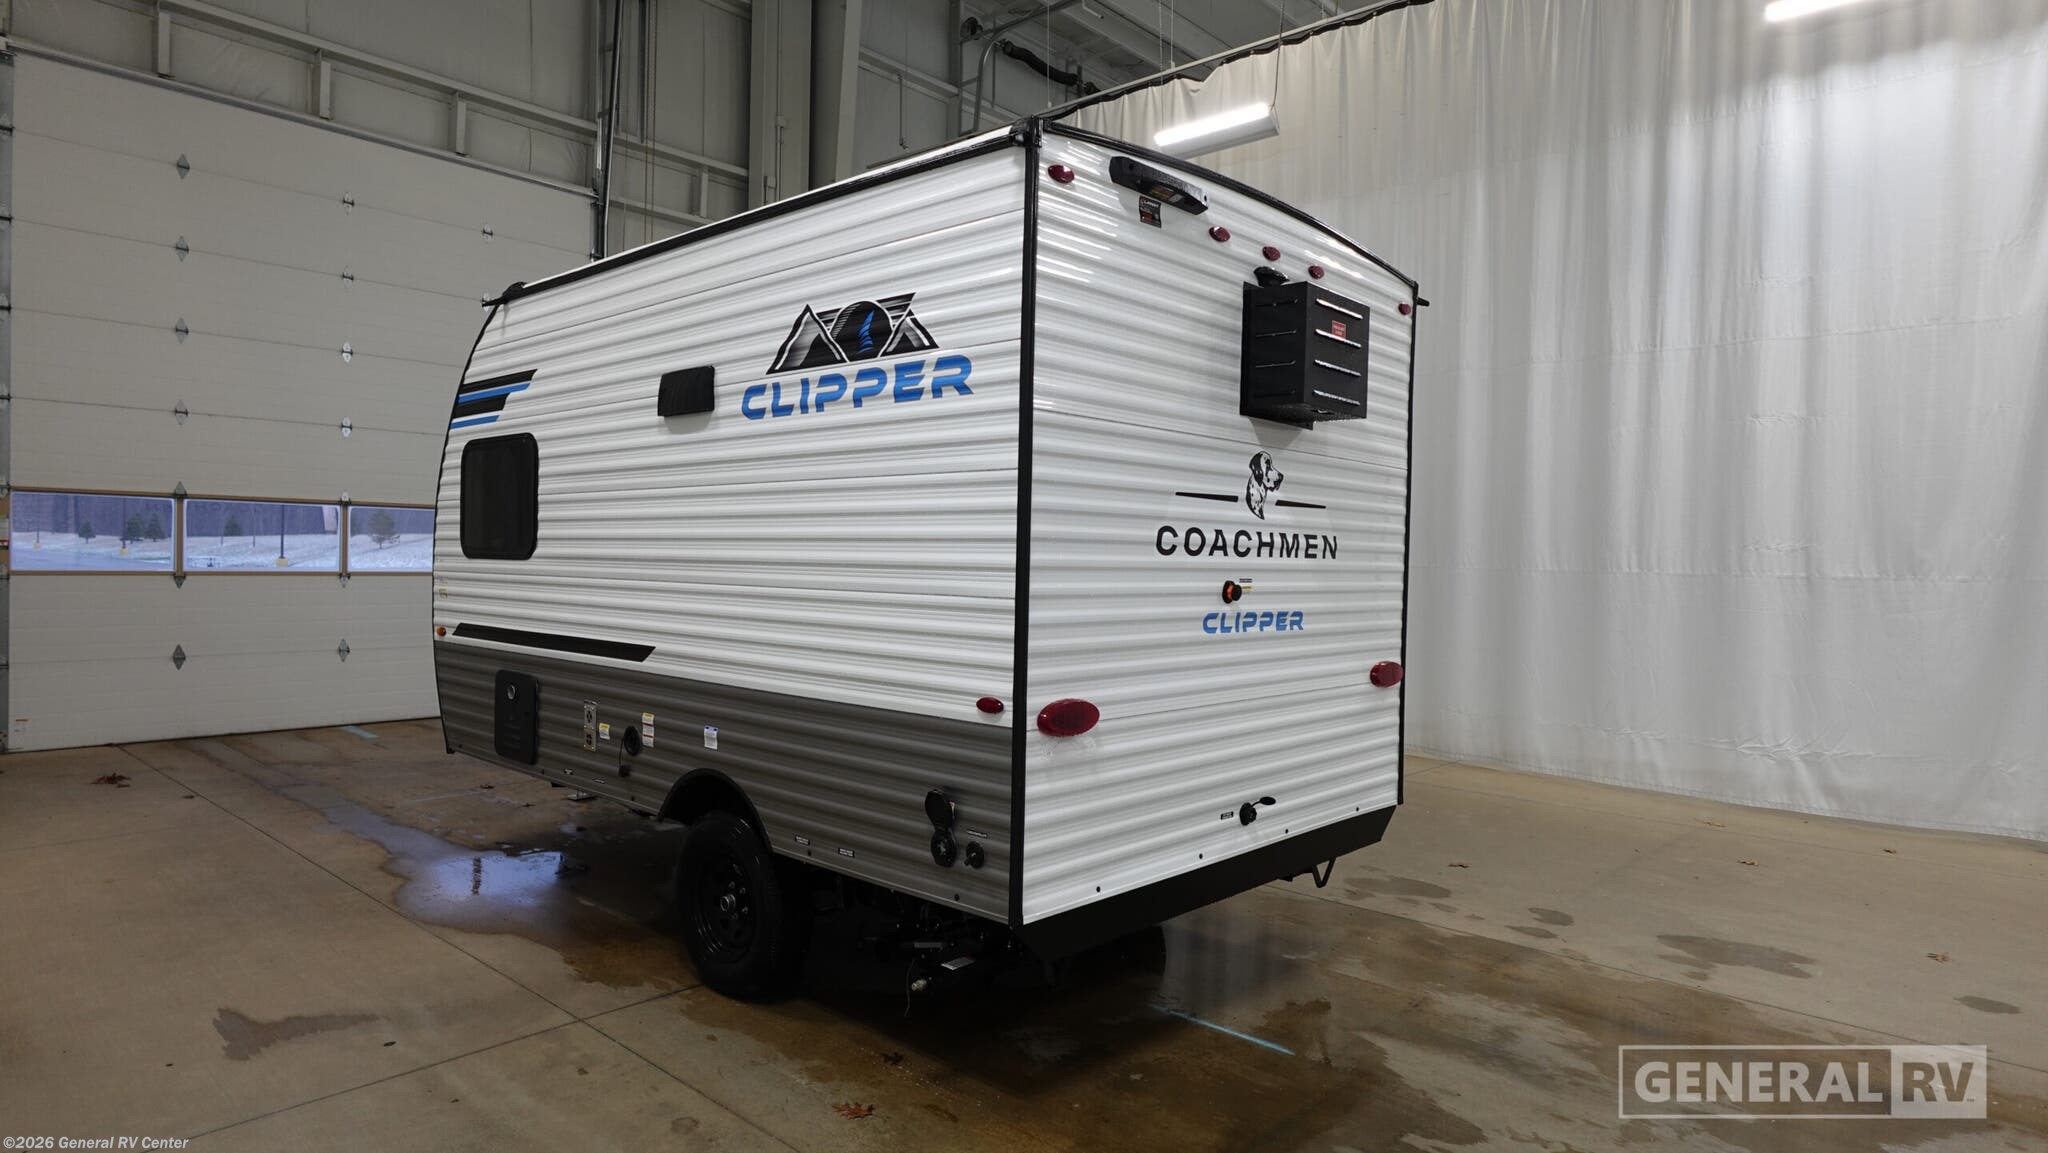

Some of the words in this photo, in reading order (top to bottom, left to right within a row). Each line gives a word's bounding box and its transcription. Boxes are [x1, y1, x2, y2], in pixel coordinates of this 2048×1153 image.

[741, 354, 974, 420] CLIPPER
[1156, 525, 1338, 560] COACHMEN
[1202, 610, 1304, 634] CLIPPER
